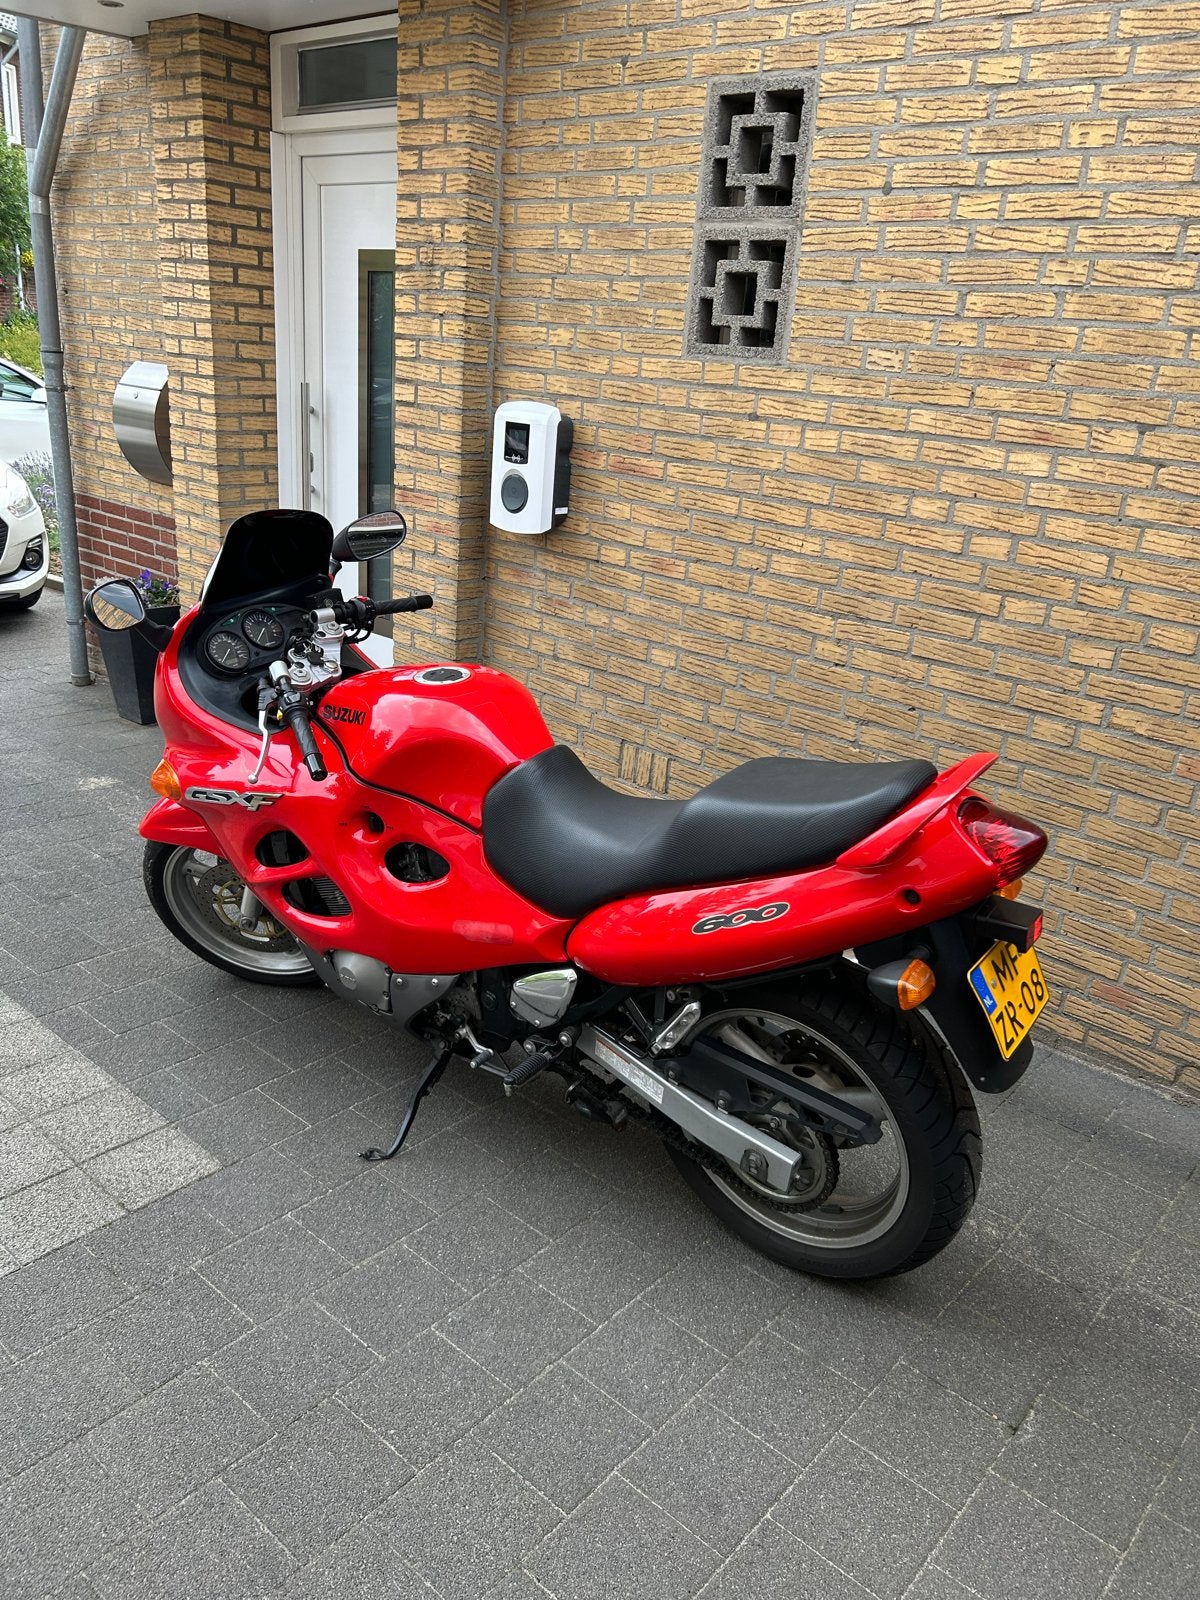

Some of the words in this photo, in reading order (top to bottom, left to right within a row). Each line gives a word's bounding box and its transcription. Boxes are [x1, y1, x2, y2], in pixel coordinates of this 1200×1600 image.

[323, 704, 367, 725] SUZUKI
[691, 901, 790, 935] 600
[983, 994, 994, 1008] NL
[995, 968, 1044, 1051] ZR-08
